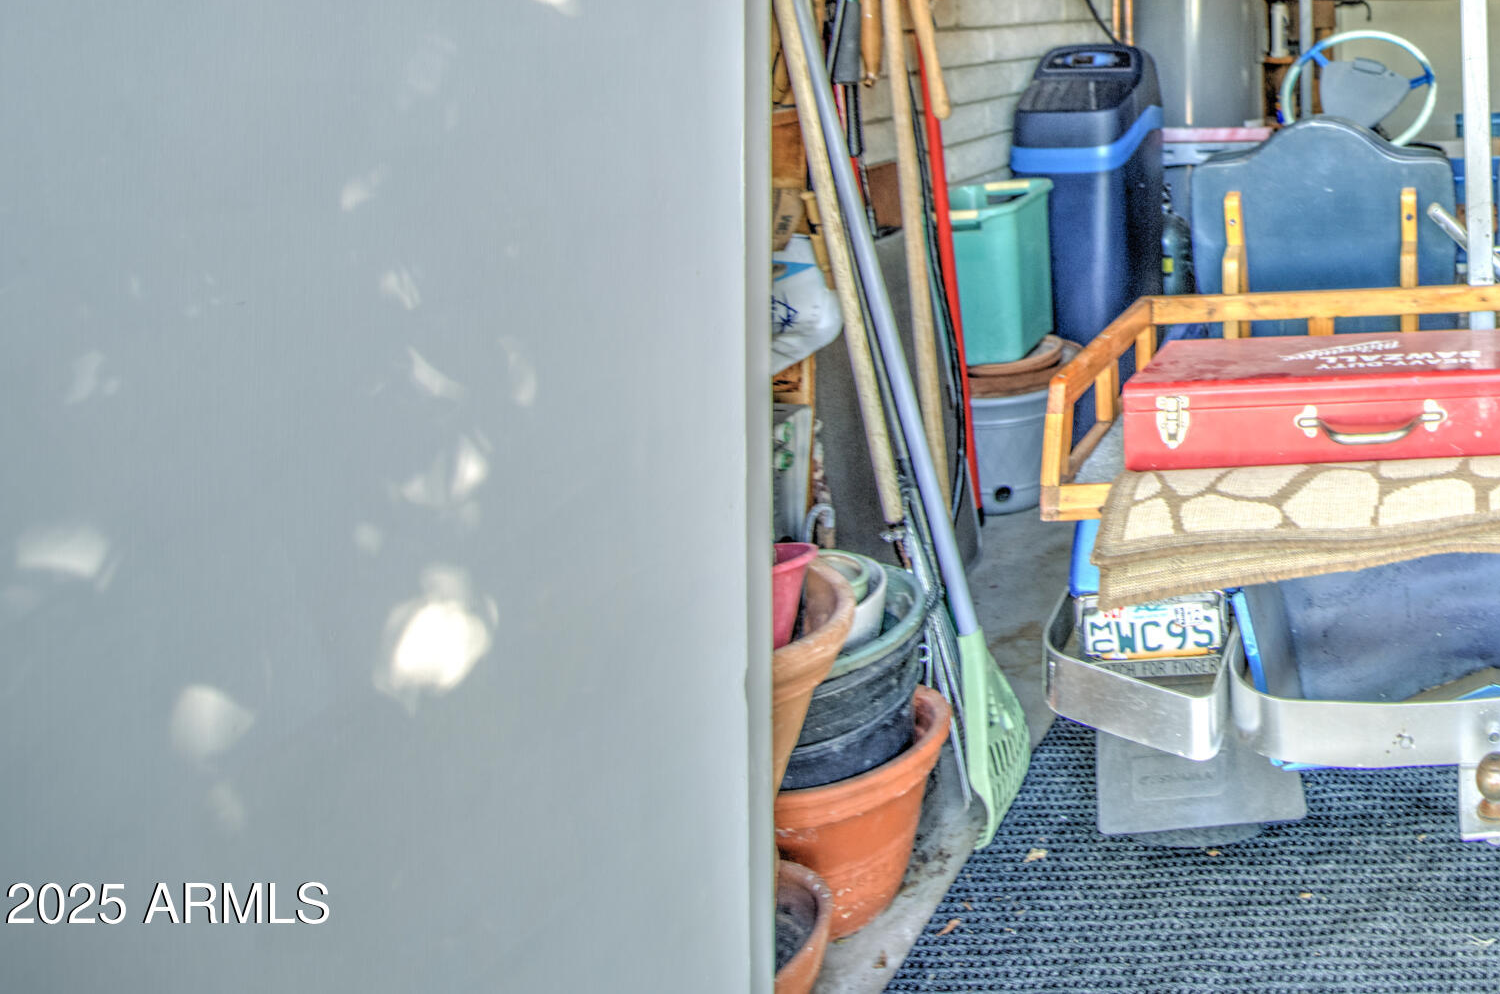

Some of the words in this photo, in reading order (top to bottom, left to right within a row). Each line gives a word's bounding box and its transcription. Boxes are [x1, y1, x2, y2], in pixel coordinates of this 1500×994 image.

[1314, 357, 1477, 370] HEAVY-DUTY
[1318, 350, 1481, 364] SAWZALL
[1142, 661, 1167, 675] FOR
